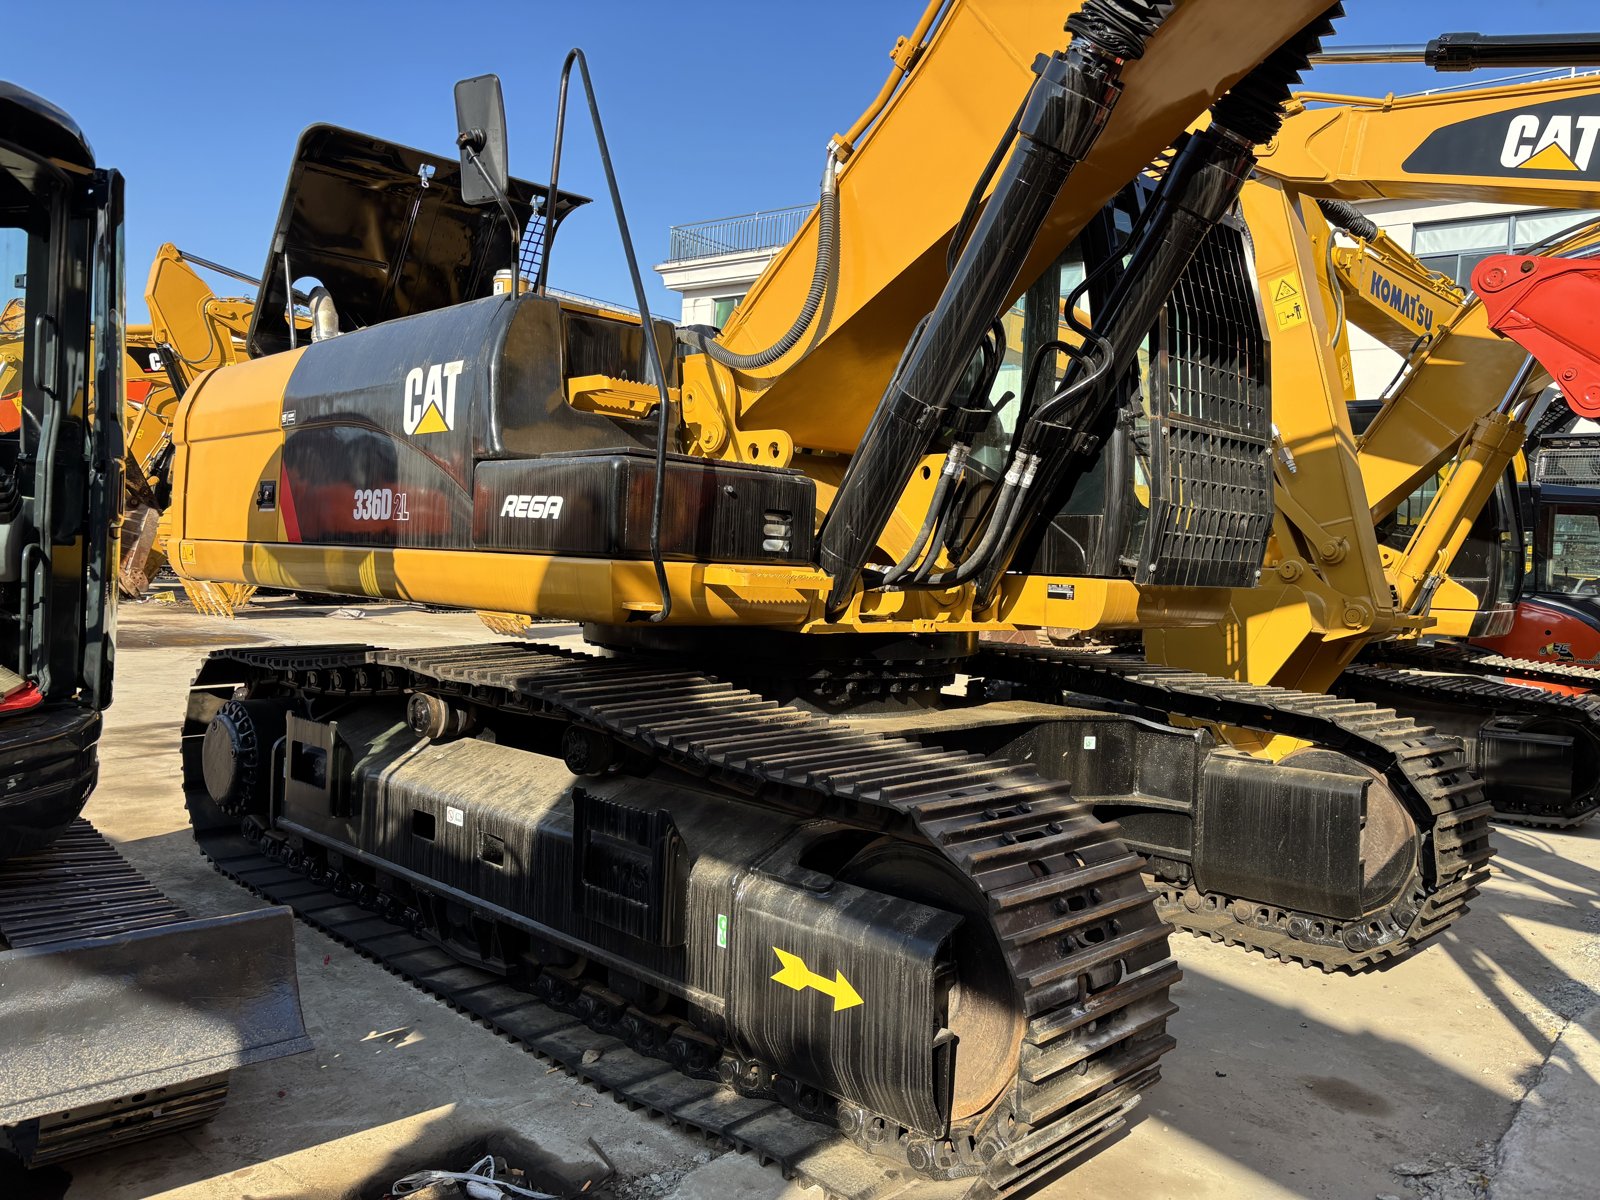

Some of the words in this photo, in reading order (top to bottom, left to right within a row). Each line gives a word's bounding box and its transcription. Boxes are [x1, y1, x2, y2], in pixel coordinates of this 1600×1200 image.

[1500, 114, 1600, 172] CAT
[1370, 270, 1433, 331] KOMATSU
[403, 360, 464, 435] CAT
[500, 494, 564, 519] REGA
